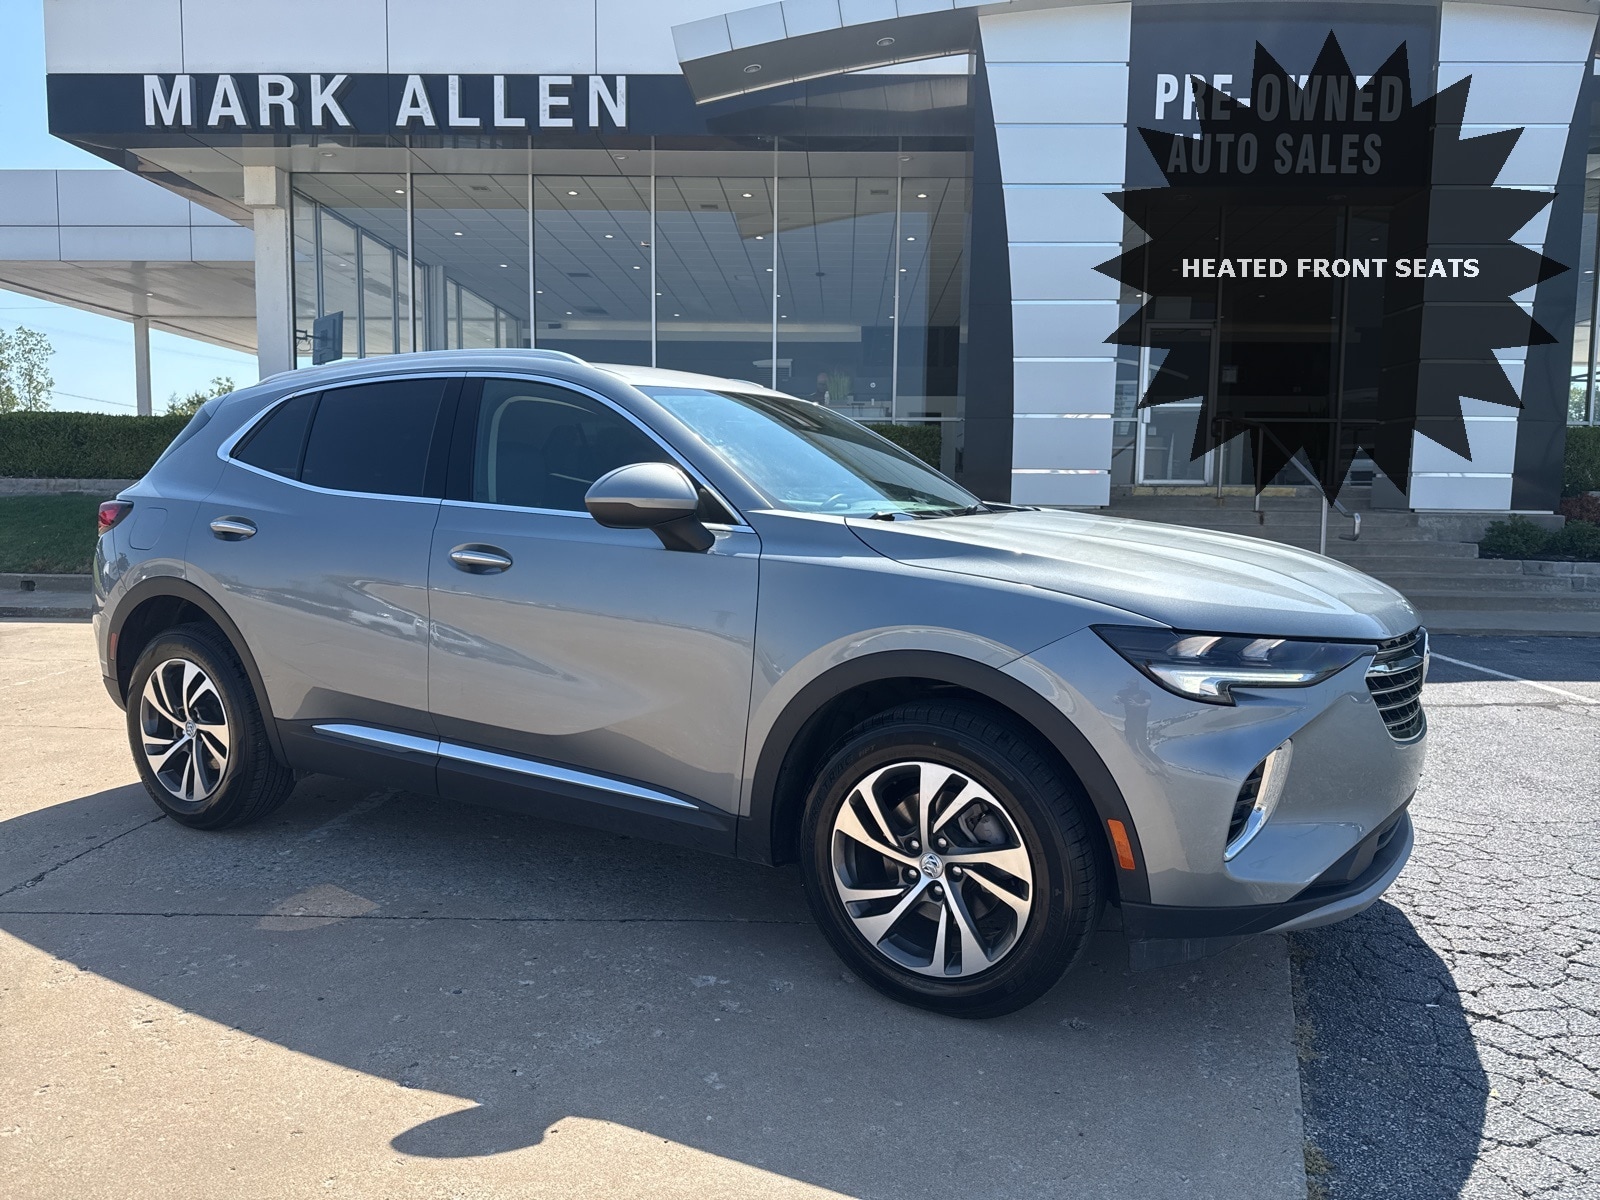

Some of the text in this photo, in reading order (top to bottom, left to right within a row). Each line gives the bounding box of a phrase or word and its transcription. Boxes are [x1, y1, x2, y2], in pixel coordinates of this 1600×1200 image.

[143, 74, 627, 127] MARK ALLEN
[1155, 73, 1404, 122] PRE-OWNED
[1166, 133, 1382, 175] AUTO SALES
